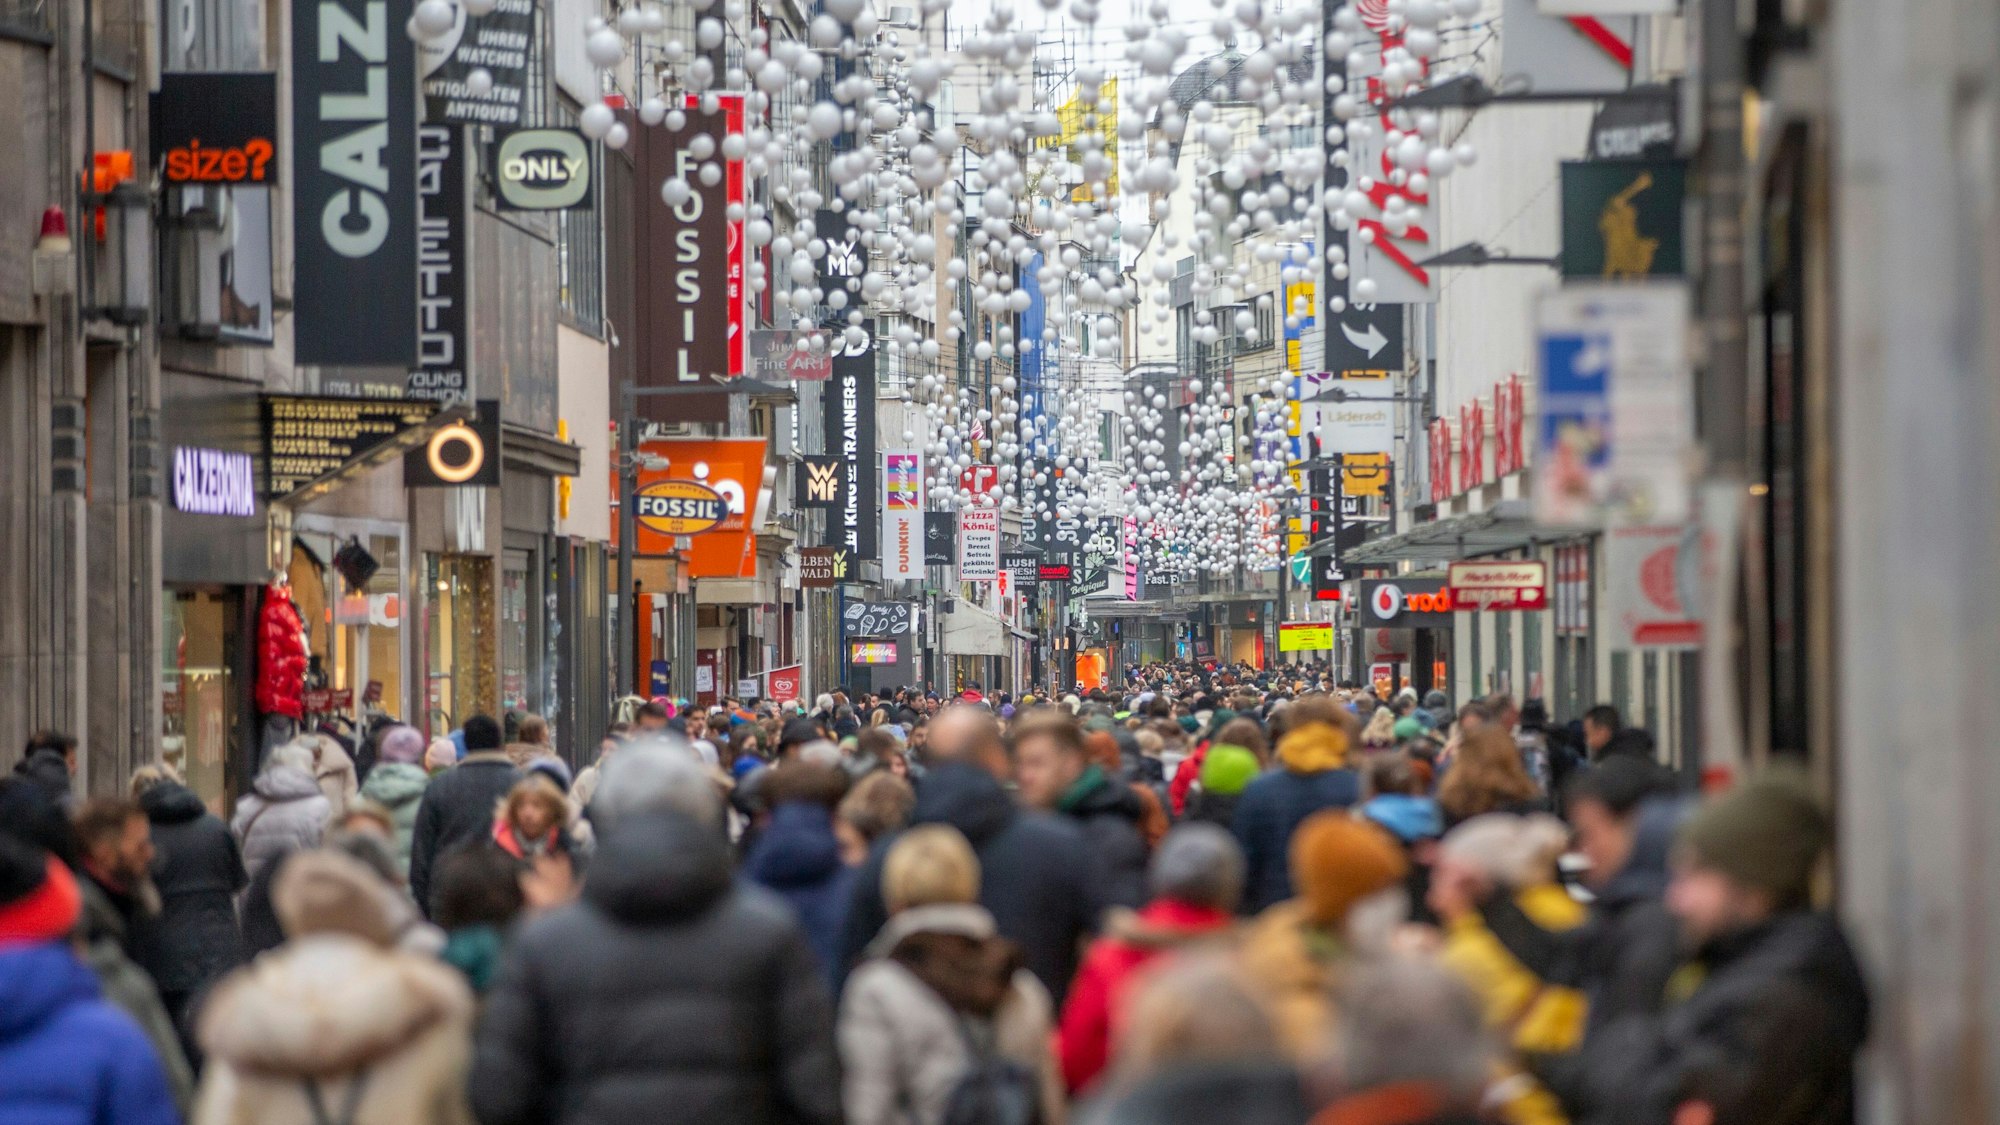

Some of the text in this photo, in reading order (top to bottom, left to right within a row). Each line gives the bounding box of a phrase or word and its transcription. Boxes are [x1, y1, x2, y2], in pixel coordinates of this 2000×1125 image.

[494, 0, 533, 15] OINS
[477, 29, 529, 49] UHREN
[456, 47, 526, 68] WATCHES
[445, 100, 519, 122] ANTIQUES
[168, 138, 273, 181] size?
[504, 157, 583, 181] ONLY
[672, 150, 704, 382] FOSSIL
[754, 356, 827, 370] Fine ART
[174, 445, 254, 516] CALZEDONIA
[806, 461, 838, 501] WMF
[639, 496, 717, 520] FOSSIL
[962, 522, 996, 532] König
[1006, 558, 1036, 567] LUSH
[1070, 579, 1106, 595] Belgique
